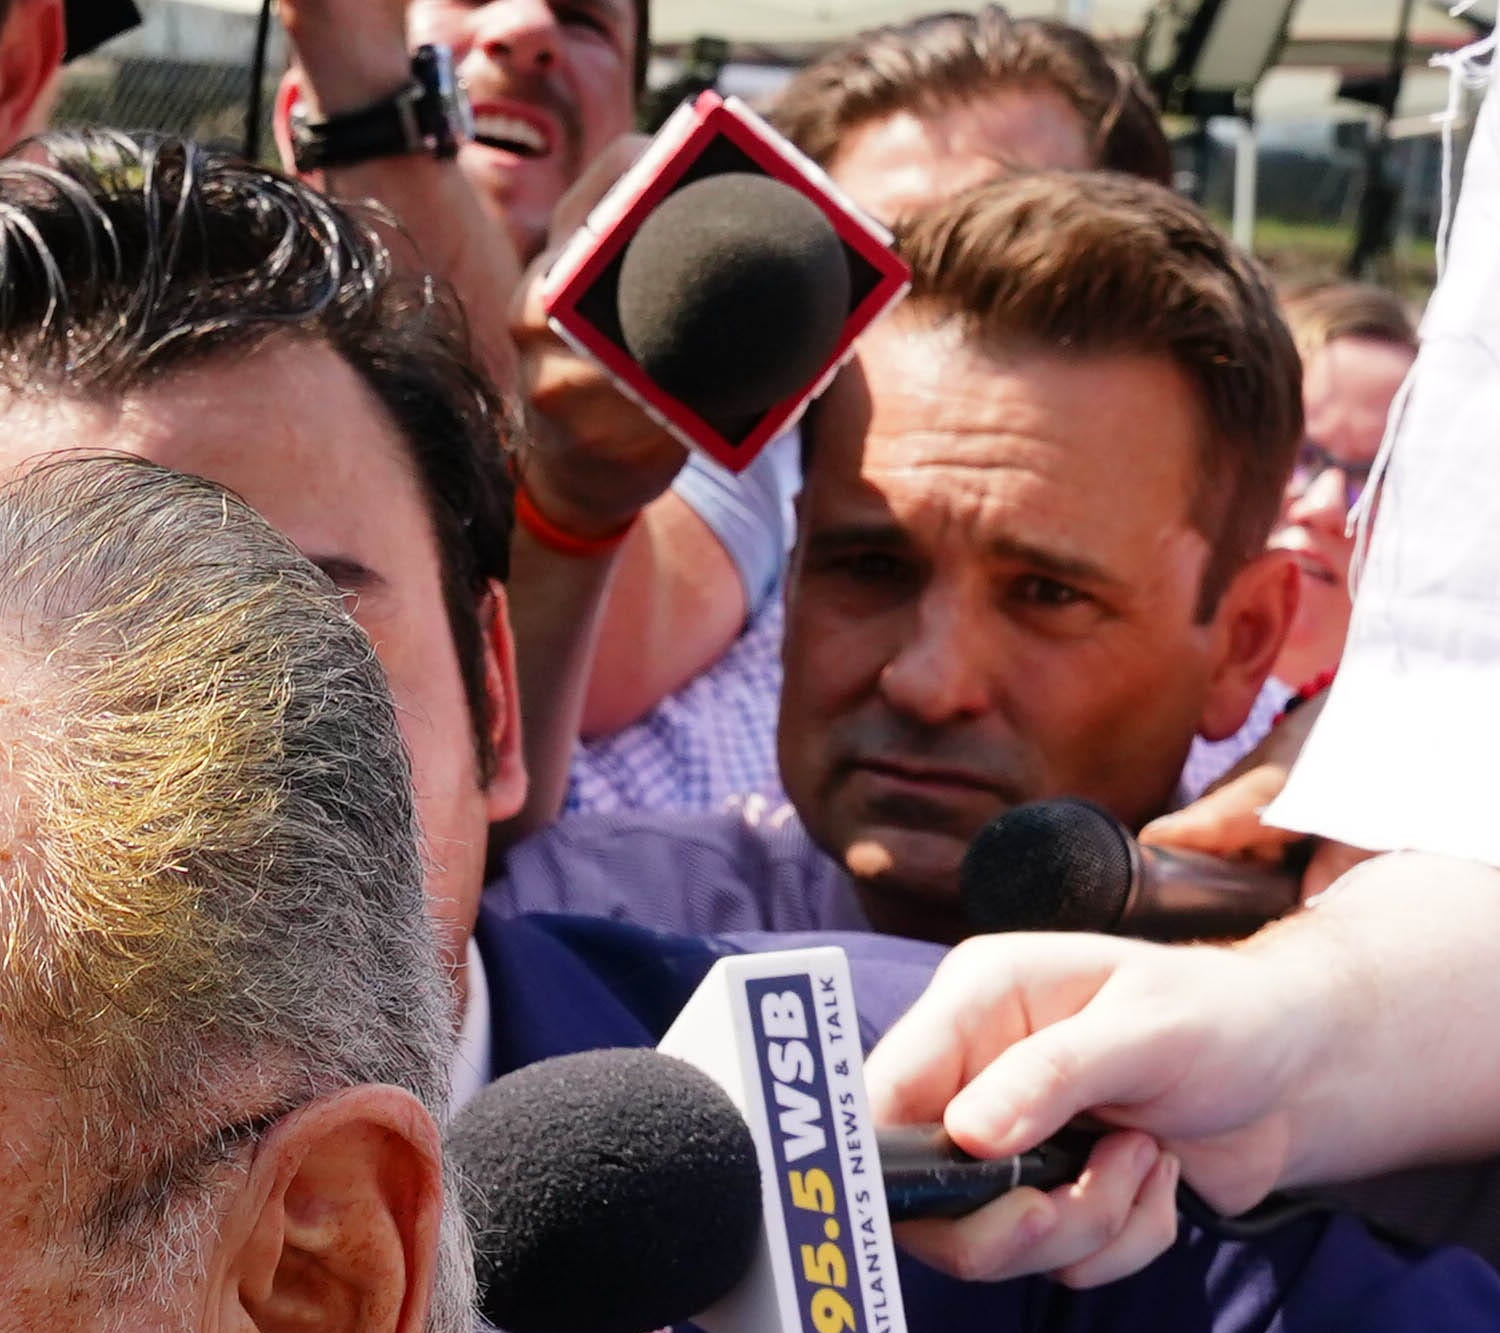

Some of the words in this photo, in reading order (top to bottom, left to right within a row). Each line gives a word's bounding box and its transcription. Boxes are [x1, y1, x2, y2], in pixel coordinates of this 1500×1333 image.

[819, 976, 843, 1045] TALK
[760, 990, 827, 1162] WSB
[835, 1059, 849, 1076] &
[839, 1092, 865, 1176] NEWS
